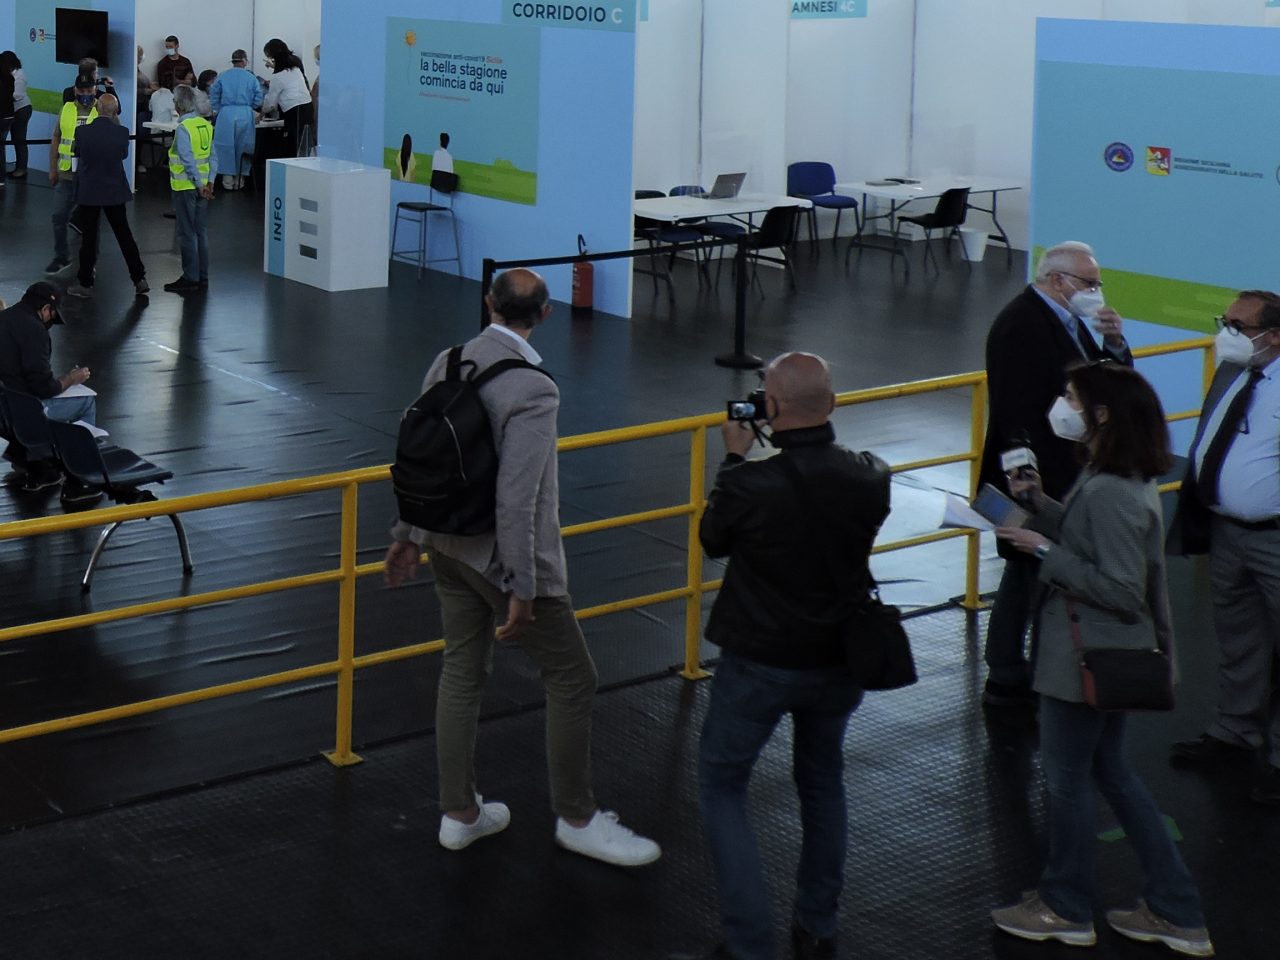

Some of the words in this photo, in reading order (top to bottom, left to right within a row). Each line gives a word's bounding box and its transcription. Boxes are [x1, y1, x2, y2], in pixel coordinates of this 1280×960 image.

[512, 2, 606, 22] CORRIDOIO
[611, 7, 623, 24] C
[840, 0, 855, 12] 4C
[420, 58, 429, 71] la
[432, 59, 456, 74] bella
[460, 62, 507, 80] stagione
[420, 74, 466, 90] comincia
[469, 78, 483, 92] da
[486, 81, 504, 96] qui
[273, 197, 282, 241] INFO
